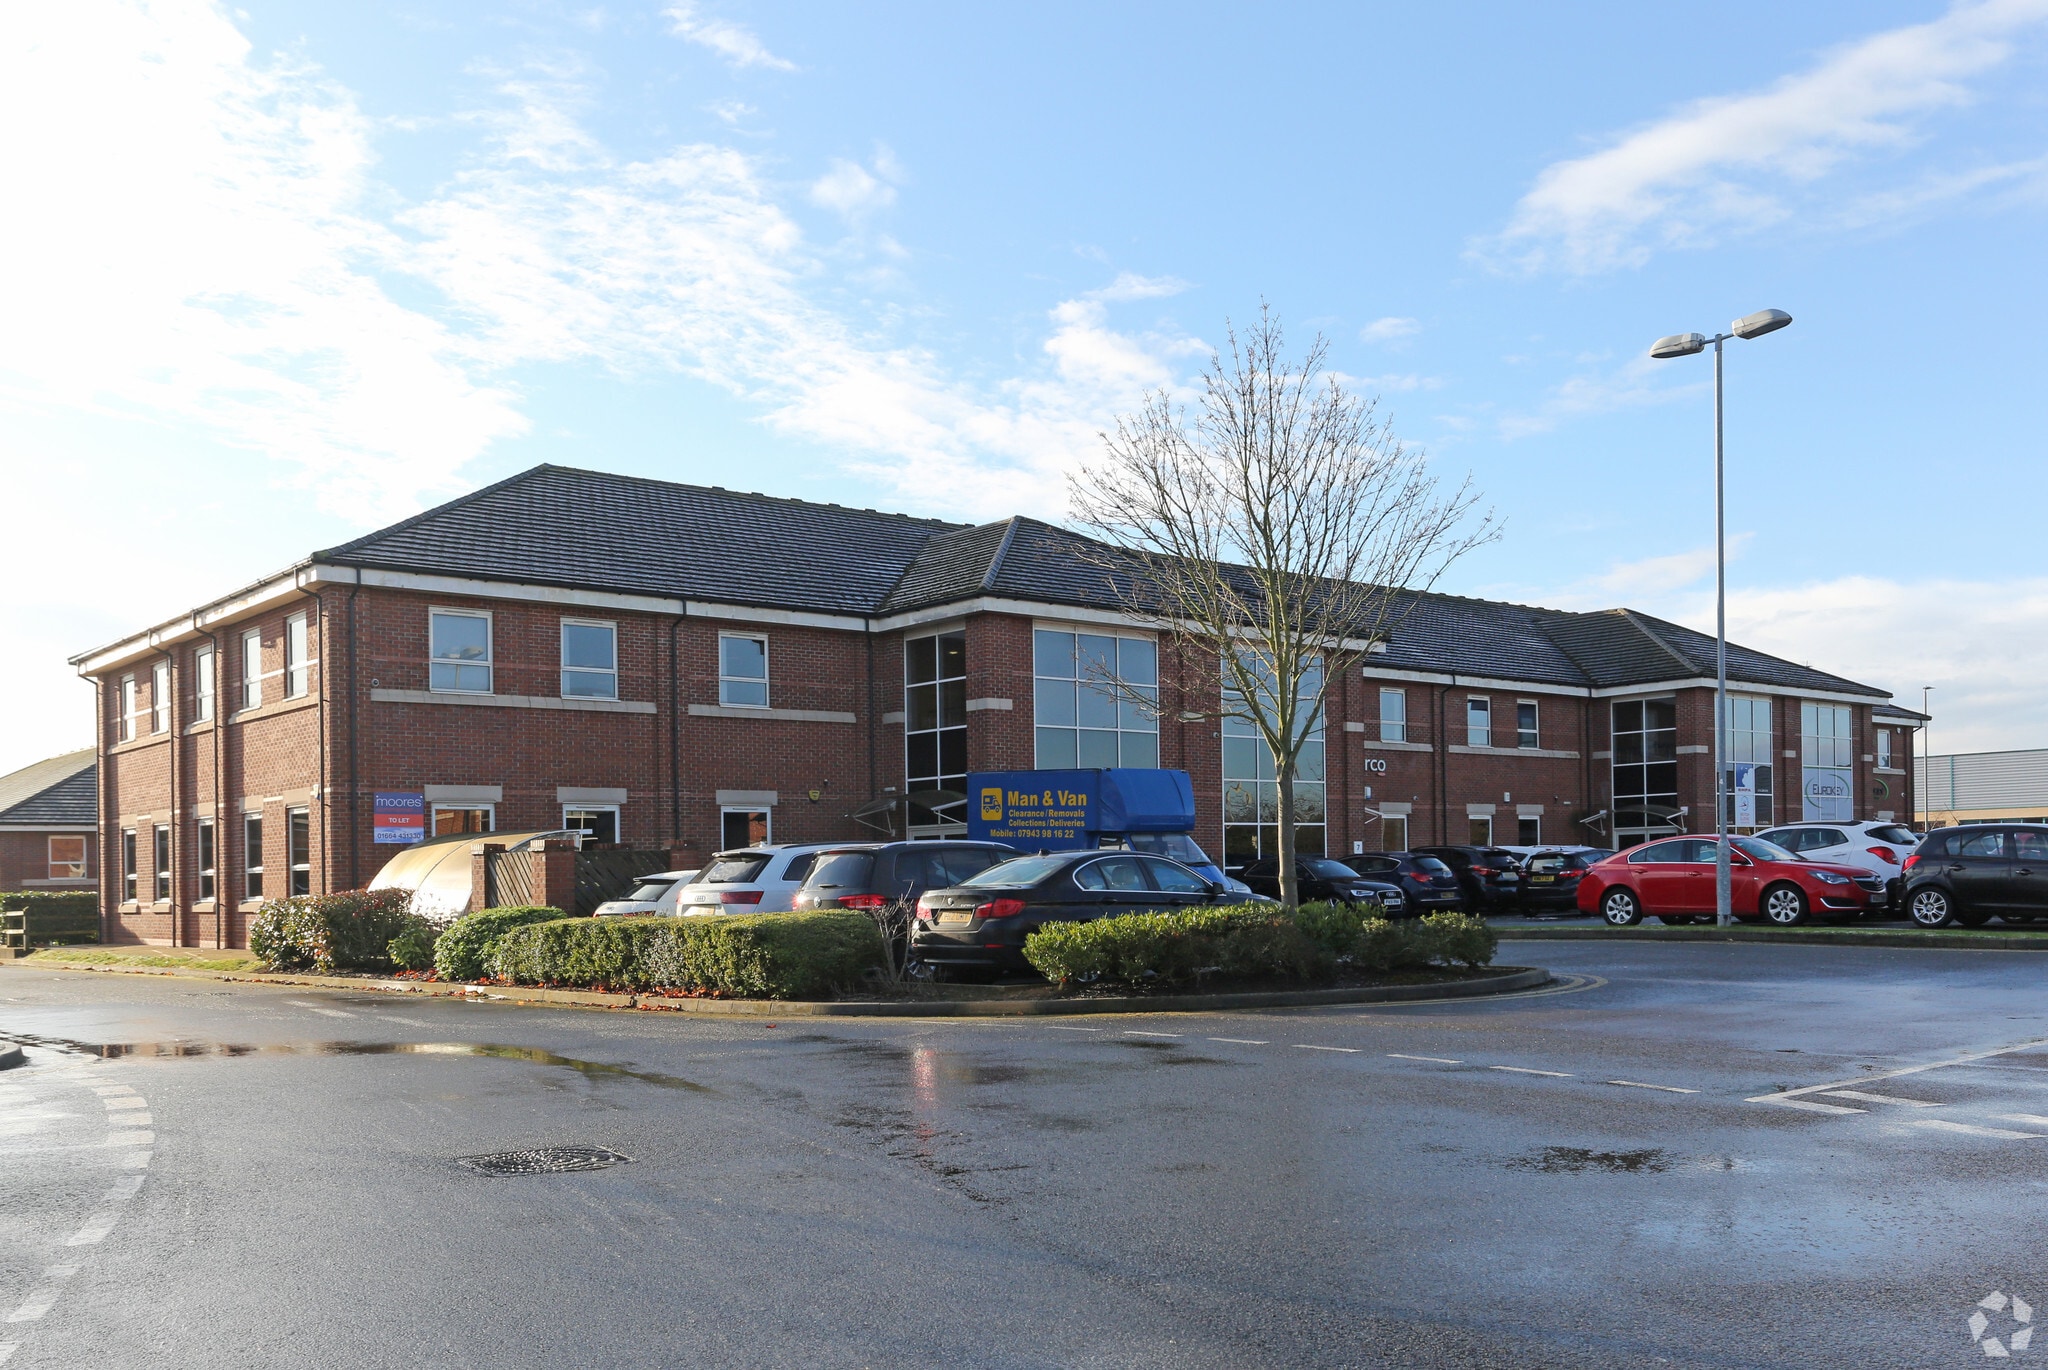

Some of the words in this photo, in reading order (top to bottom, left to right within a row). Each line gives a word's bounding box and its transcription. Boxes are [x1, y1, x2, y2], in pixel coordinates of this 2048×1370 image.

[1812, 783, 1844, 796] EUROKEY
[376, 798, 422, 807] moores
[1007, 790, 1038, 806] Man
[1042, 790, 1054, 806] &
[1057, 790, 1087, 806] Van
[990, 829, 1016, 837] Mobile:
[1017, 829, 1040, 837] 07943
[1041, 829, 1052, 837] 98
[1054, 829, 1063, 837] 16
[1064, 829, 1075, 838] 22
